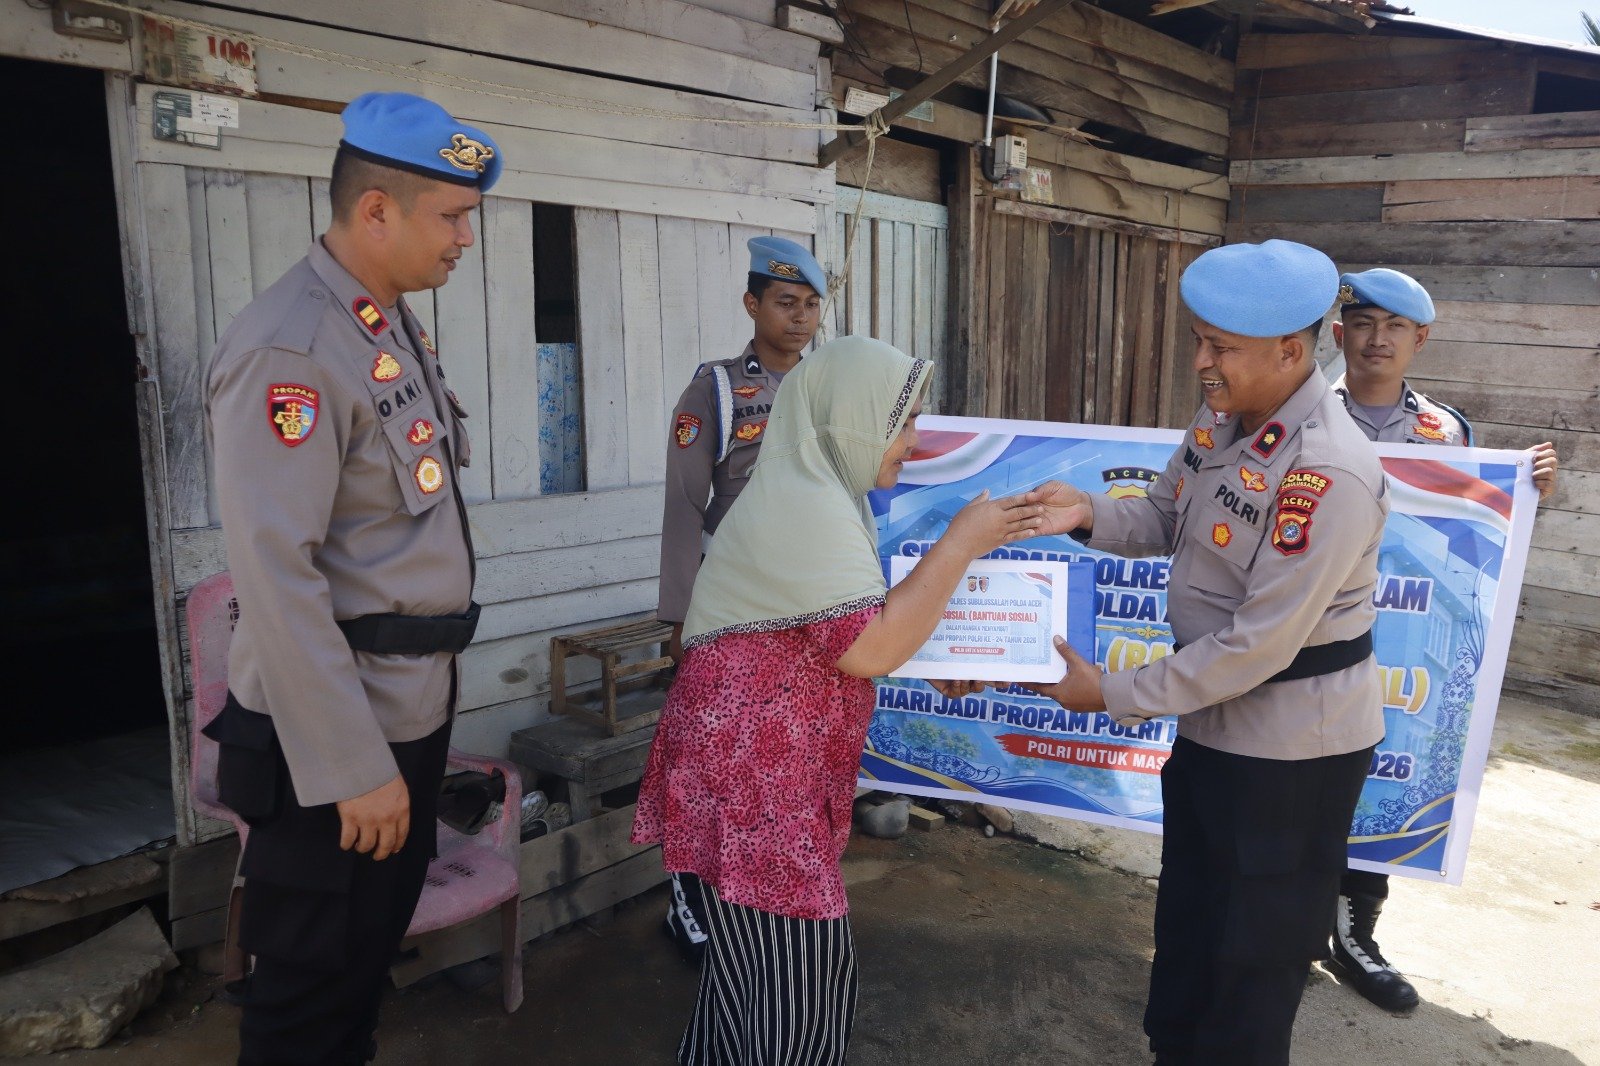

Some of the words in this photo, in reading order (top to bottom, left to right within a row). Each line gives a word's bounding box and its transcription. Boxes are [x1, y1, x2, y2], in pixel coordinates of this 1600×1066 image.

[273, 387, 315, 399] PROPAM
[1110, 470, 1158, 481] ACEH
[1215, 484, 1259, 525] POLRI
[1282, 498, 1312, 508] ACEH
[1080, 556, 1171, 590] OLRE
[1010, 599, 1027, 608] POLDA
[1028, 600, 1042, 608] ACEH
[943, 611, 967, 621] SOSIAL
[969, 611, 1007, 621] (BANTUAN
[1008, 612, 1038, 623] SOSIAL)
[879, 687, 932, 712] HARI
[934, 696, 987, 719] JADI
[992, 701, 1087, 733] PROPAM
[1028, 740, 1070, 759] POLRI
[1076, 747, 1128, 766] UNTUK
[1132, 753, 1168, 771] MAS
